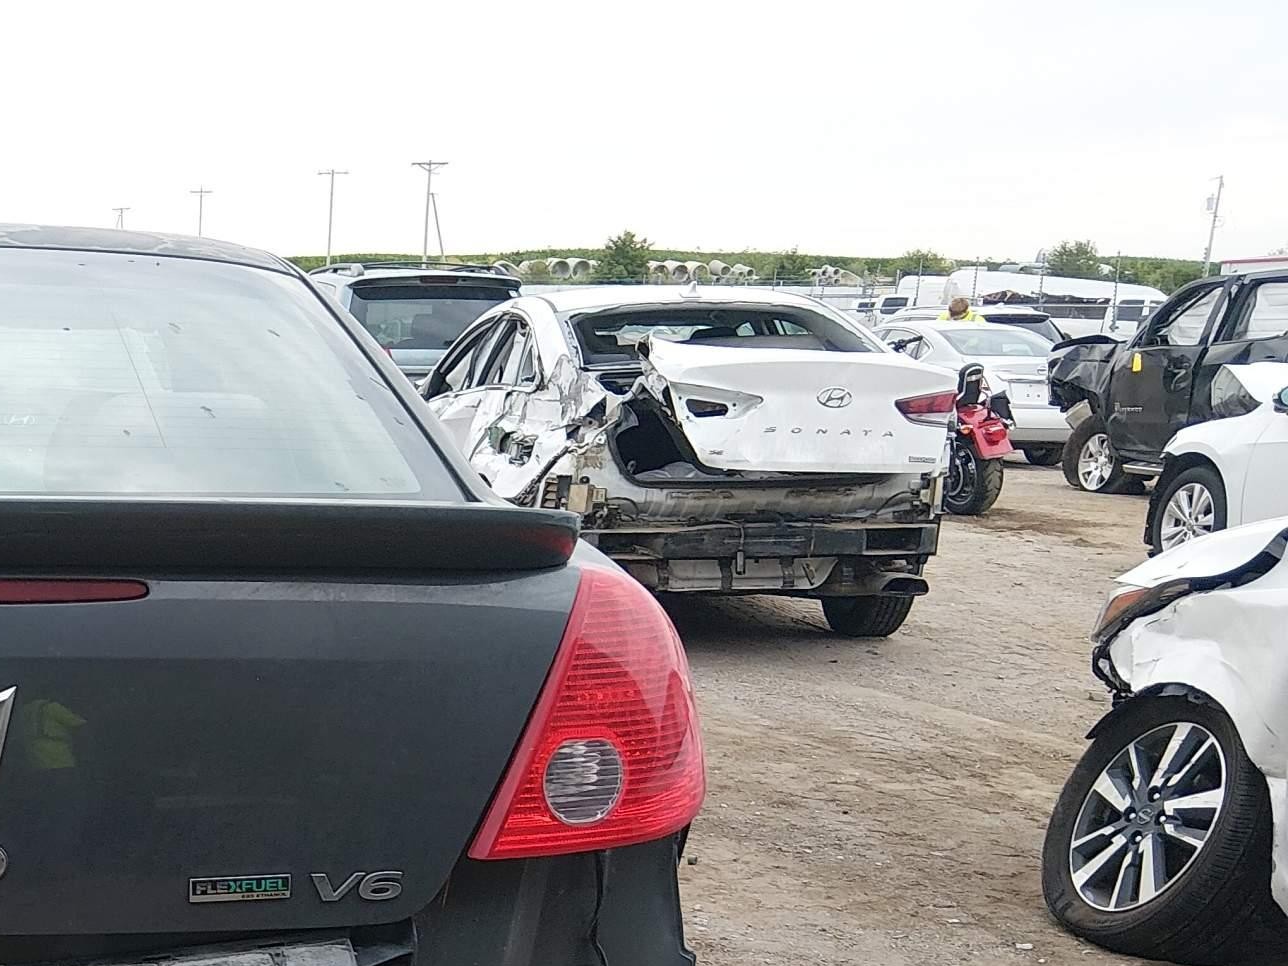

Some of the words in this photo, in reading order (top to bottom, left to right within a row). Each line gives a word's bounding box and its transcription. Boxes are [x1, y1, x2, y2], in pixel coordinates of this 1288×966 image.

[764, 426, 894, 438] SONATA
[195, 879, 288, 895] FLEXFUEL
[311, 870, 405, 903] V6
